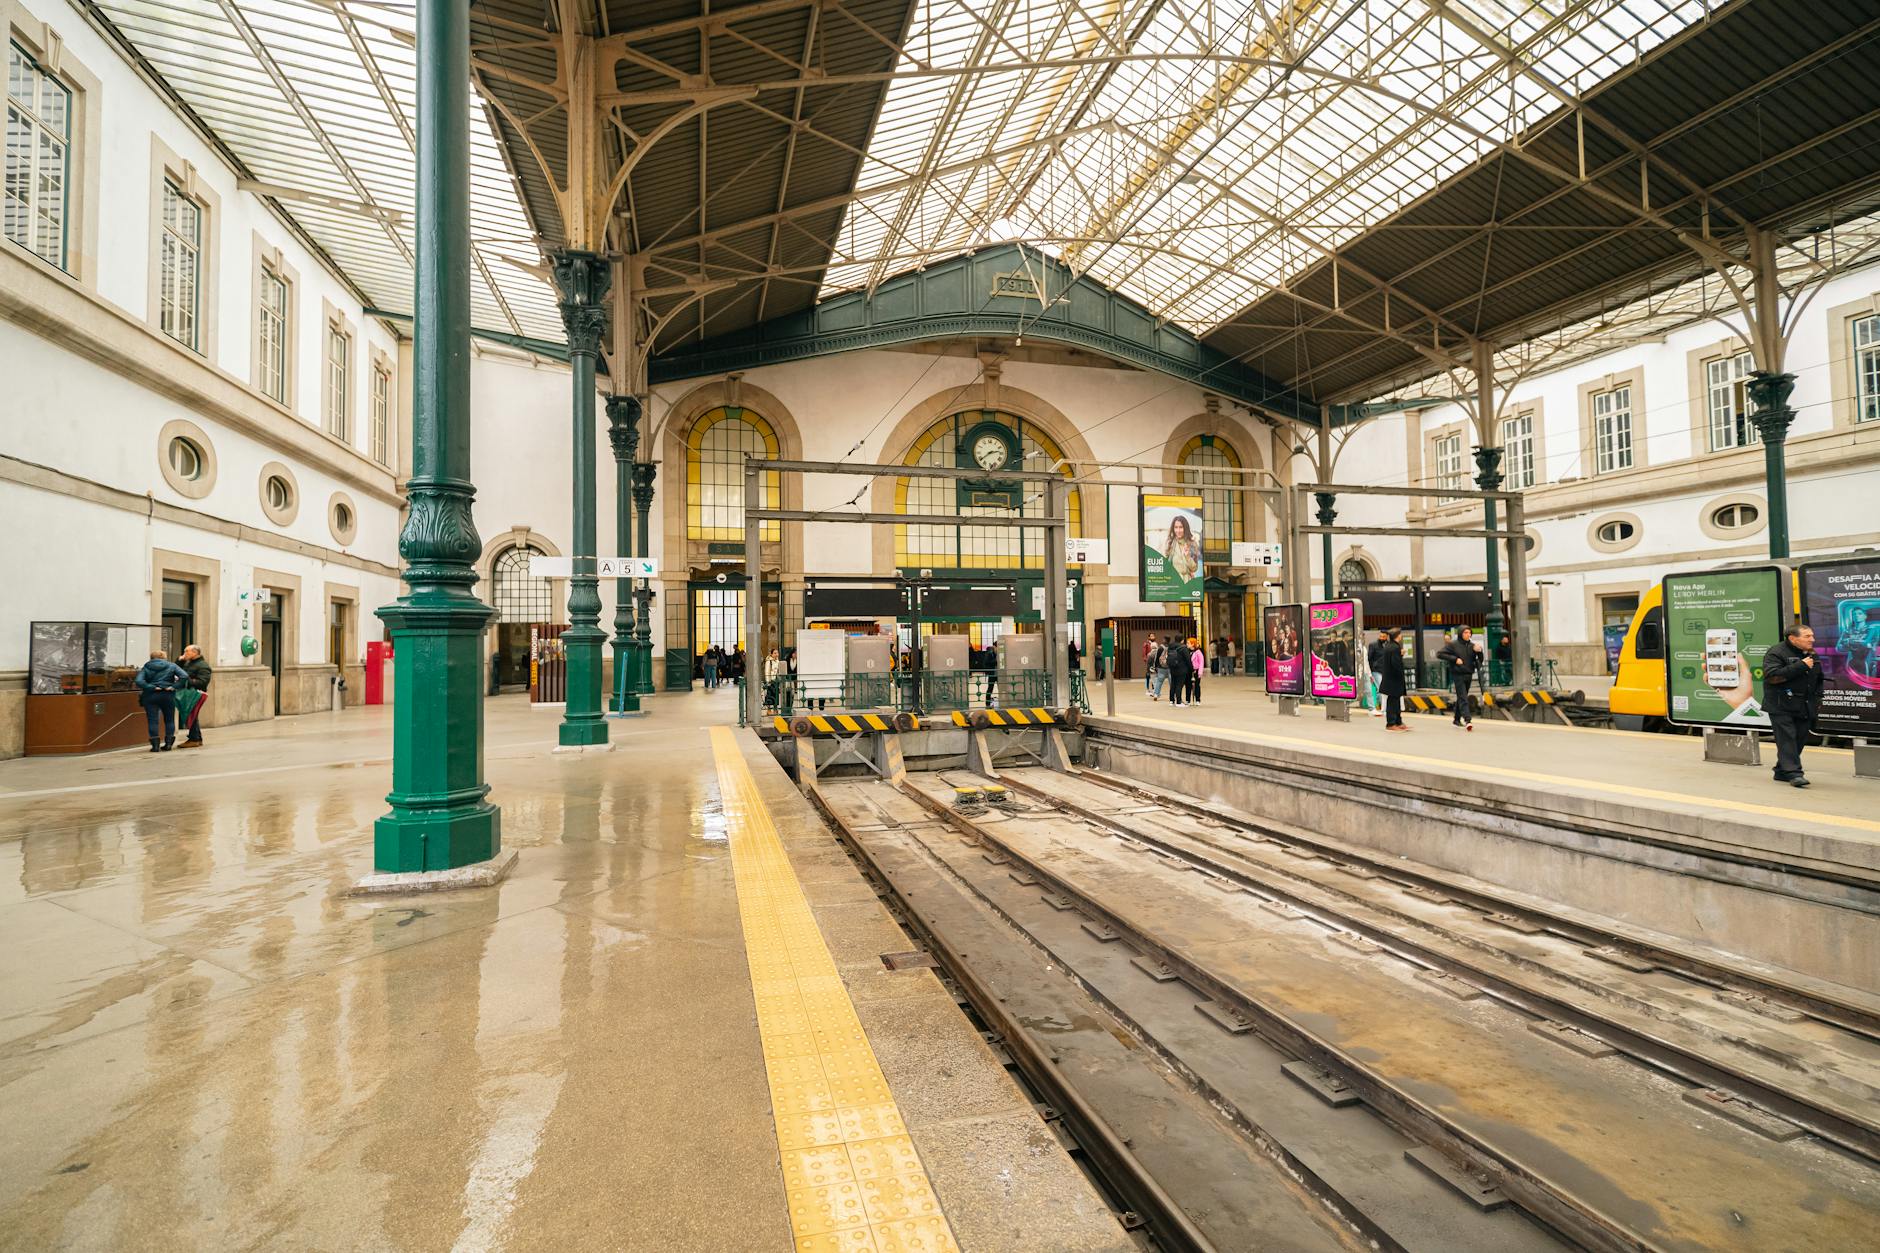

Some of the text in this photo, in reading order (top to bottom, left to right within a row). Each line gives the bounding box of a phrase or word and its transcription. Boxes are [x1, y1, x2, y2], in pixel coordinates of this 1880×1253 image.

[603, 563, 631, 574] A 5
[1828, 574, 1872, 583] DESAFIA
[1697, 589, 1726, 597] MERLIN
